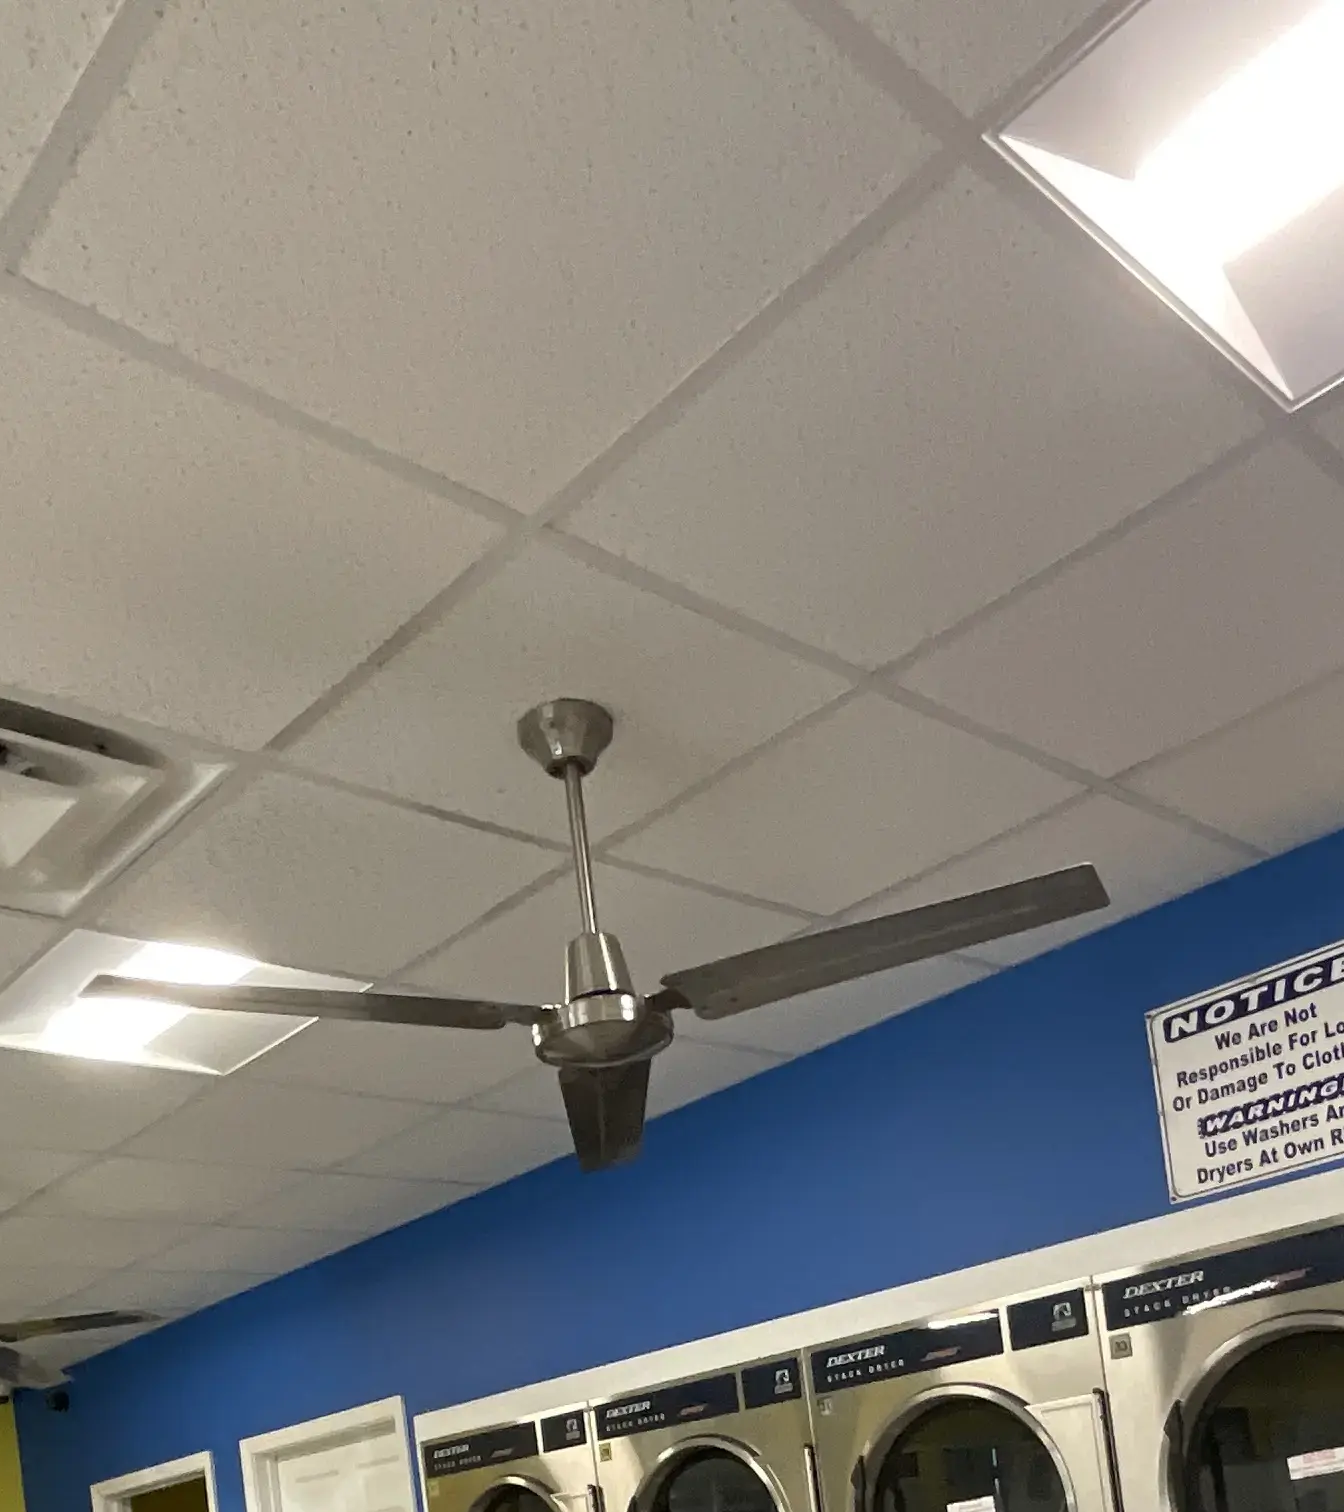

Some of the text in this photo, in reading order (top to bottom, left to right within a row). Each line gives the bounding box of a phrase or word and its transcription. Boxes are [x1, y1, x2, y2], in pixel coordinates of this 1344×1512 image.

[1214, 1002, 1317, 1050] We Are Not
[1176, 1042, 1282, 1088] Responsible
[1288, 1029, 1318, 1051] For
[1172, 1092, 1192, 1112] Or
[1197, 1069, 1268, 1105] Damage
[1273, 1061, 1296, 1080] To
[1205, 1136, 1238, 1158] Use
[1242, 1112, 1320, 1147] Washers
[1197, 1155, 1254, 1185] Dryers
[1259, 1147, 1279, 1168] At
[1284, 1135, 1325, 1159] Own
[1123, 1270, 1205, 1300] DEXTER
[826, 1344, 886, 1369] DEXTER
